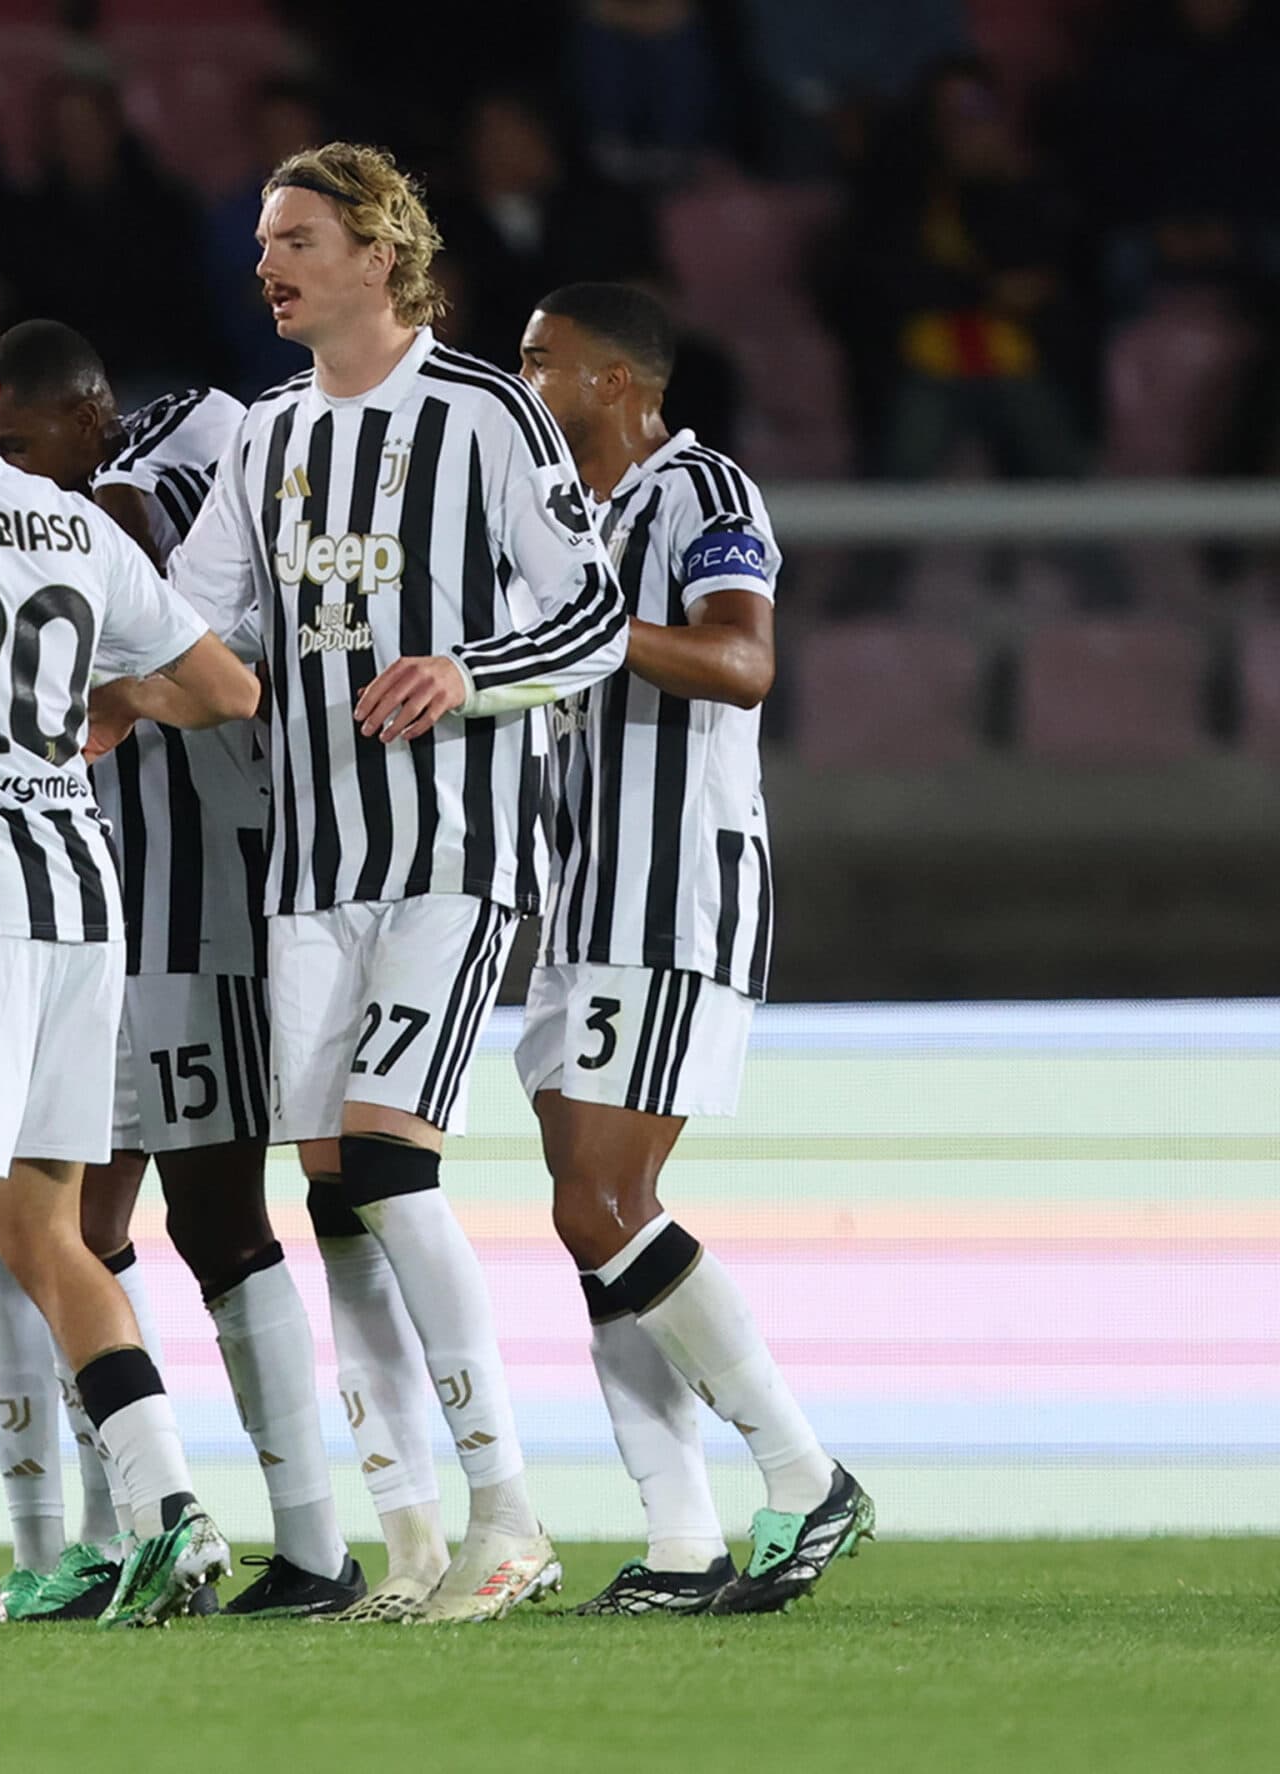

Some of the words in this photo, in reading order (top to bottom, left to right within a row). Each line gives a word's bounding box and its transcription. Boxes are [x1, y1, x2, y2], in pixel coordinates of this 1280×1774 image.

[274, 520, 405, 595] Jeep
[687, 545, 763, 577] PEAC
[298, 622, 374, 659] Detroit
[350, 1002, 431, 1077] 27
[576, 996, 622, 1070] 3
[150, 1043, 218, 1124] 15
